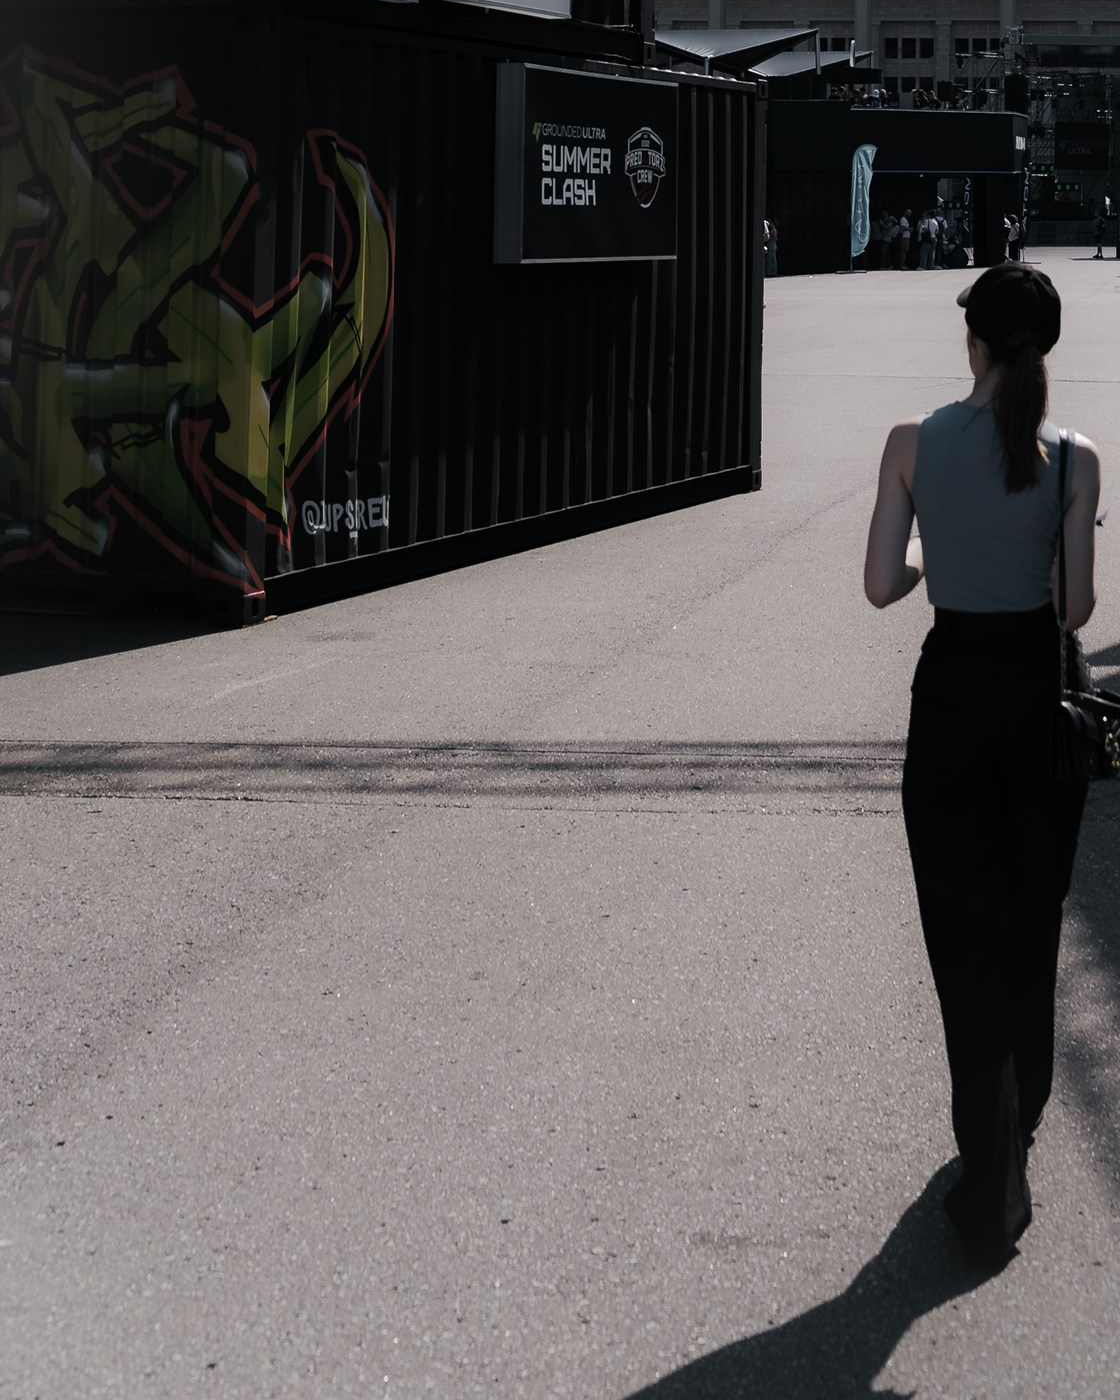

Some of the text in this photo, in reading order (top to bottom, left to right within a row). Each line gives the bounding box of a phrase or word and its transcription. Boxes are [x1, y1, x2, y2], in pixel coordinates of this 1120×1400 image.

[541, 143, 612, 175] SUMMER
[636, 169, 654, 184] CREW
[541, 177, 597, 207] CLASH
